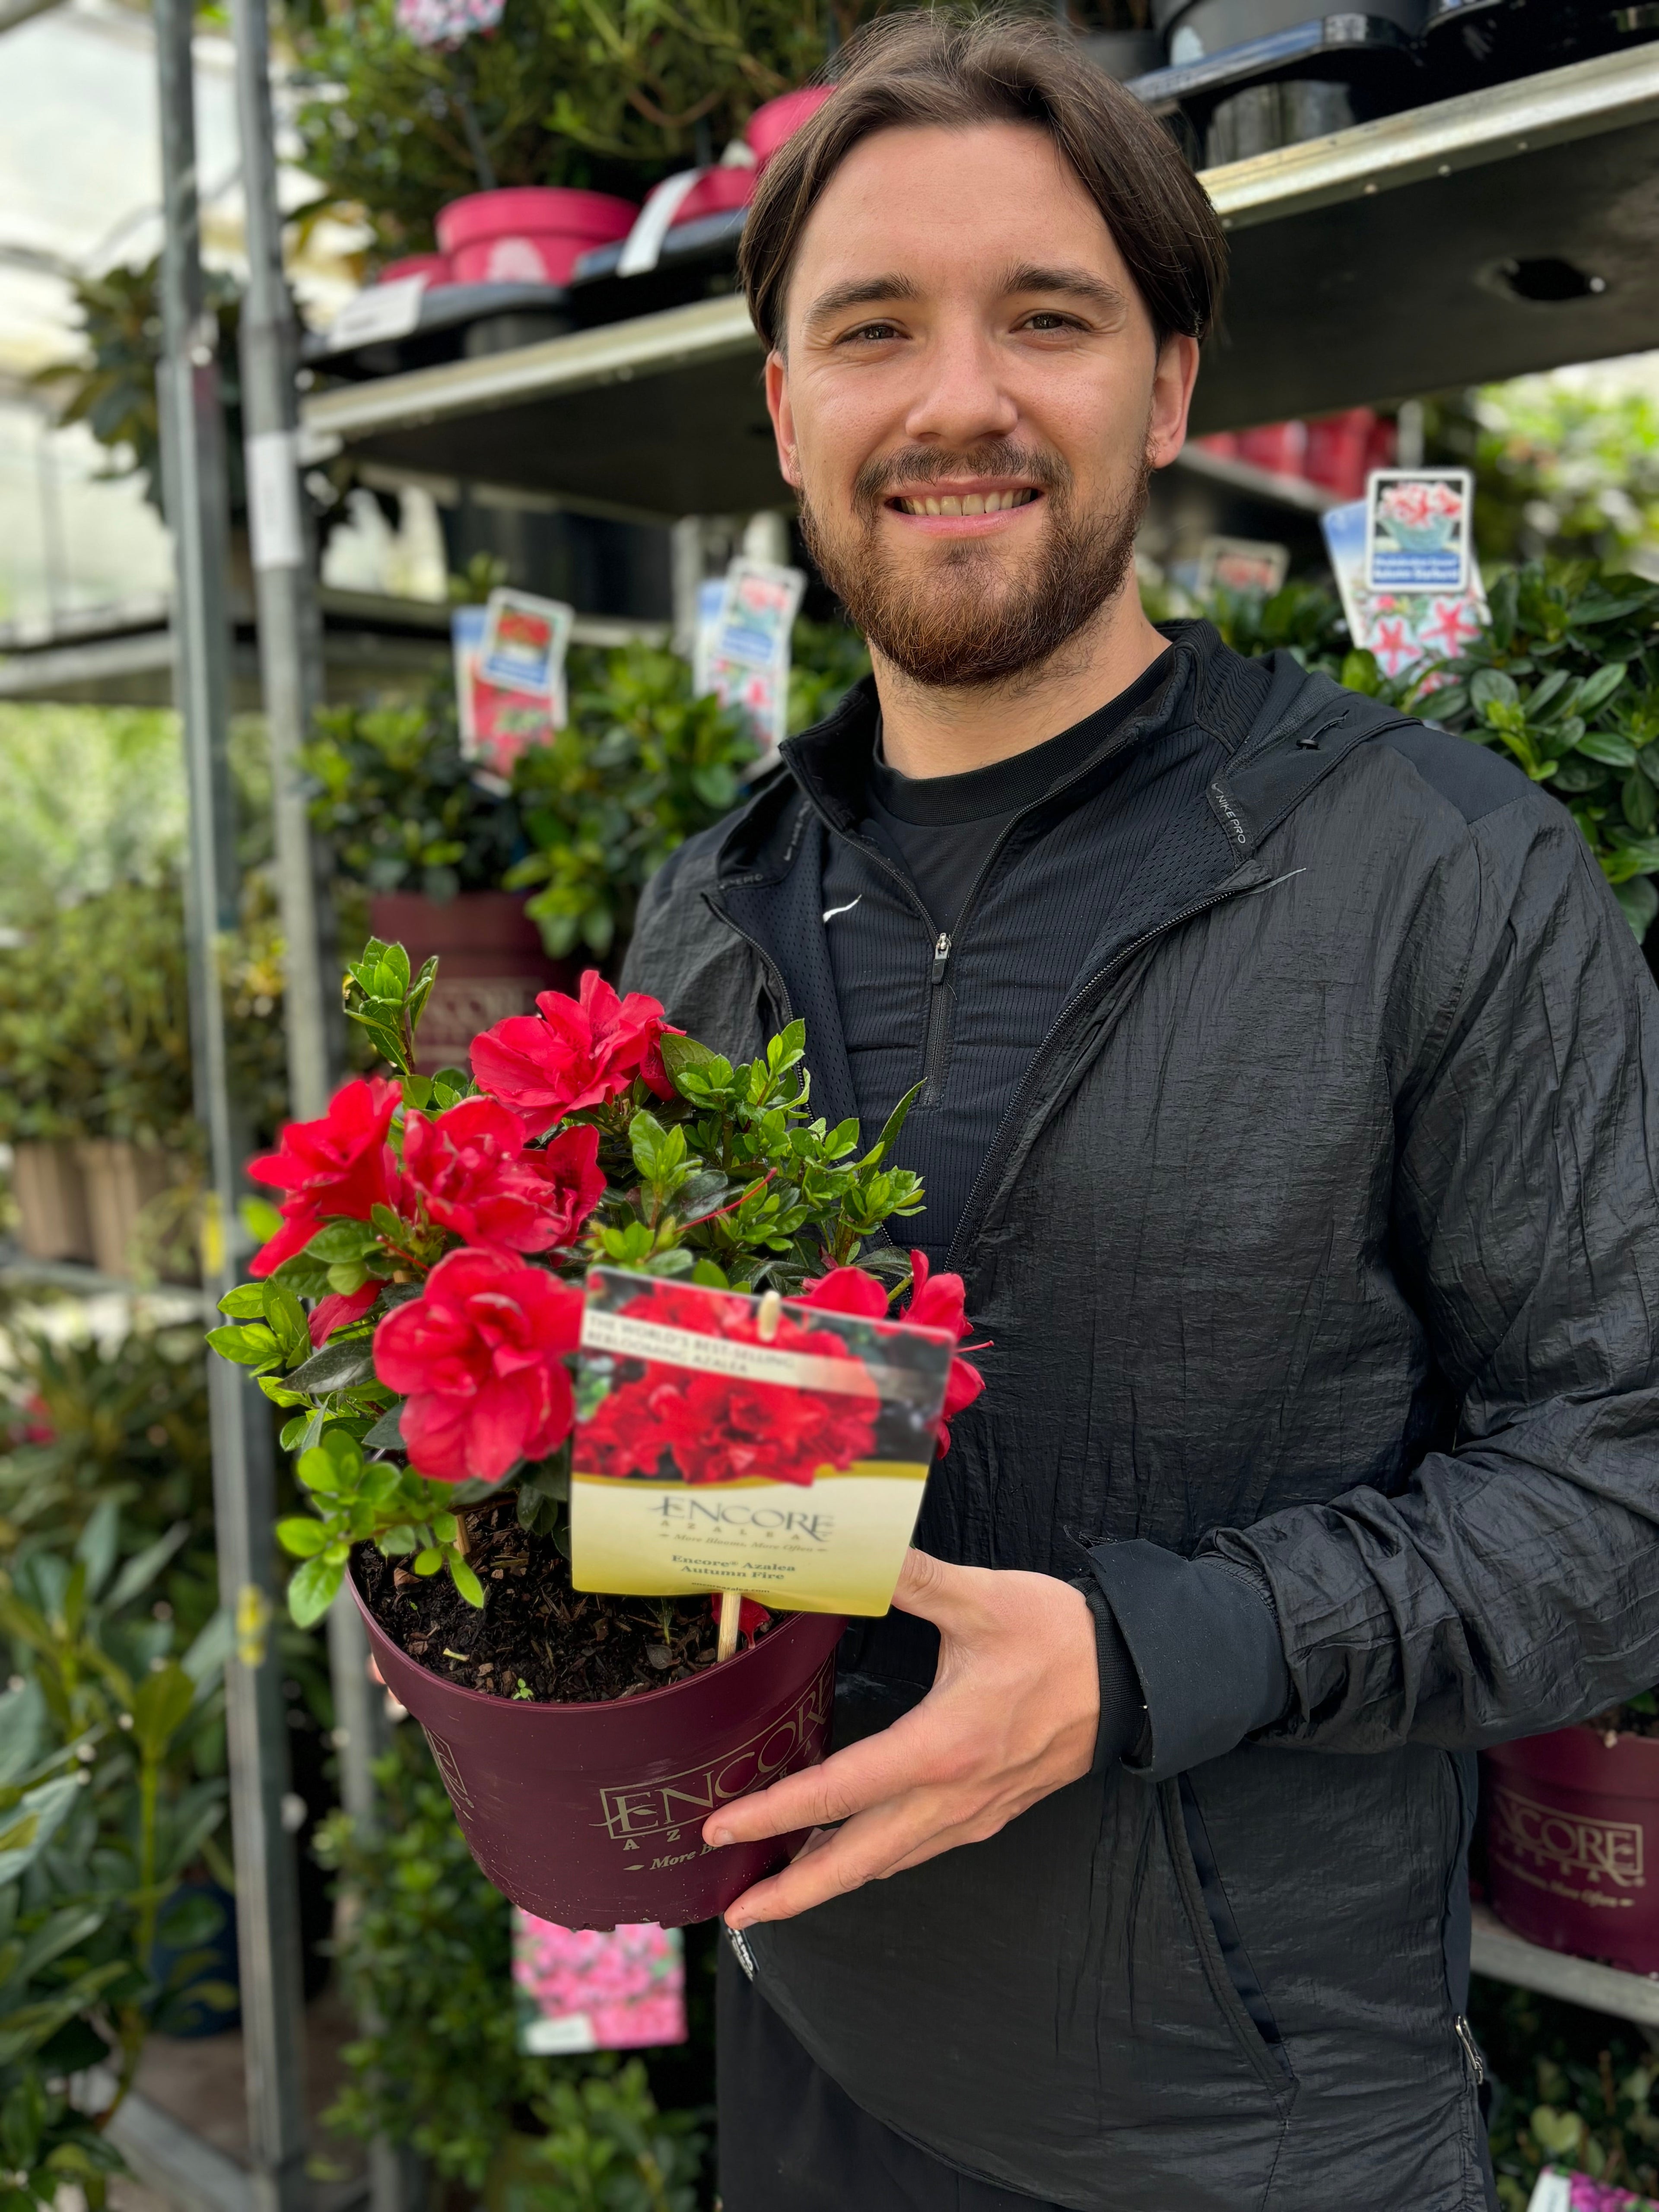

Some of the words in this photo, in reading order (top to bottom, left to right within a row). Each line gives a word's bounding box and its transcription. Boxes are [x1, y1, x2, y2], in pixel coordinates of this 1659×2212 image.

[1216, 795, 1236, 818] NIKE
[1230, 819, 1246, 844] PRO
[590, 1316, 616, 1330] THE
[621, 1323, 690, 1349] WORLD'S
[648, 1496, 834, 1542] ENCORE
[674, 1533, 702, 1543] More
[706, 1537, 747, 1547] Blooms,
[752, 1541, 780, 1550] More
[783, 1543, 813, 1552] Often
[681, 1565, 747, 1578] Autumn
[752, 1571, 785, 1580] Fire
[743, 1562, 795, 1571] Azalea
[588, 1672, 833, 1833] ENCORE
[649, 1850, 696, 1870] More
